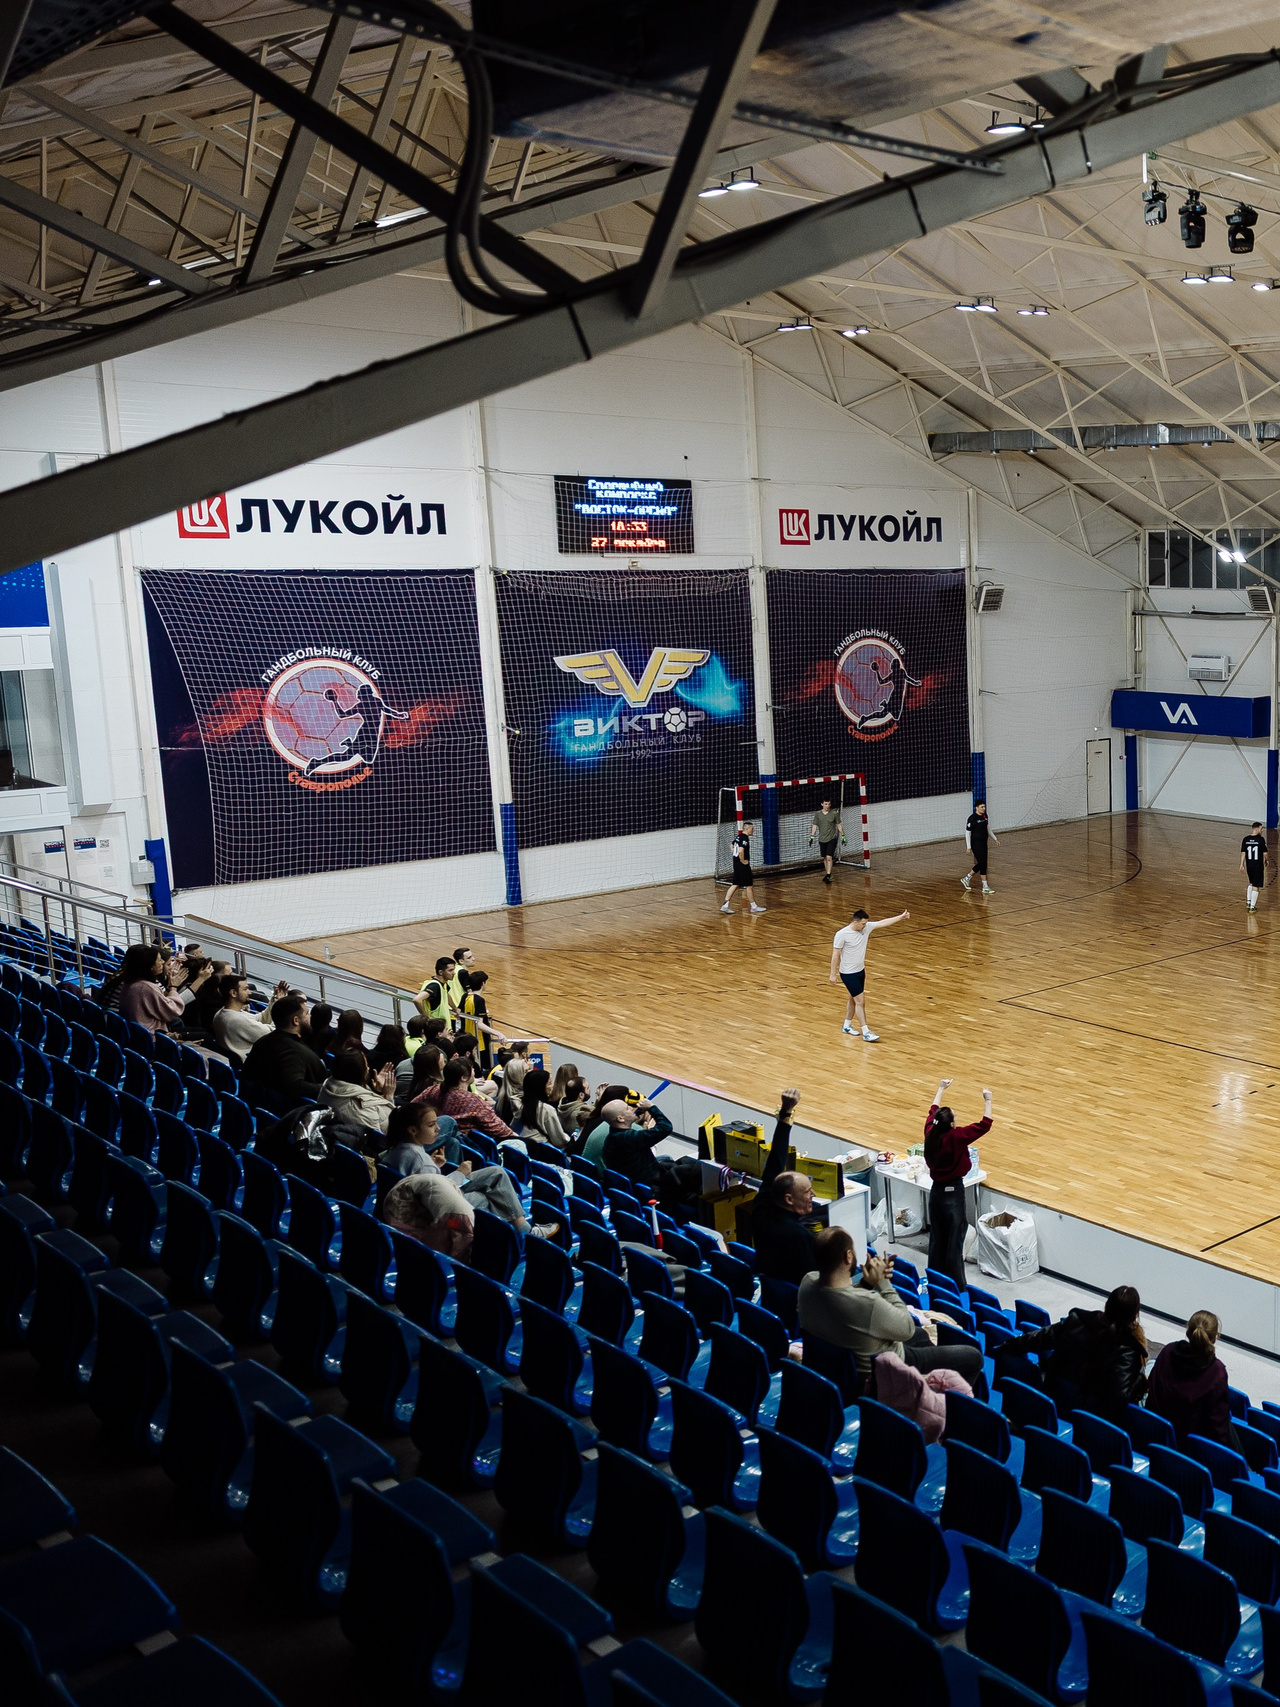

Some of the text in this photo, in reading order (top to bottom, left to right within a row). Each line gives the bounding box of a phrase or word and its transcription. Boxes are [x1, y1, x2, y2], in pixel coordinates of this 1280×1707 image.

[236, 493, 447, 536] ЛУКОЙЛ
[814, 509, 943, 543] ЛУКОЙЛ
[833, 628, 907, 657] ГАНДБОЛЬНЫЙ КЛУБ
[261, 646, 382, 683] ГАНДБОЛЬНЫЙ КЛУБ
[574, 733, 703, 753] ГАНДБОЛЬНЫЙ КЛУБ
[847, 721, 900, 743] Ставрополье
[630, 748, 652, 759] 1992
[287, 766, 374, 794] Ставрополье
[1246, 845, 1259, 860] 11
